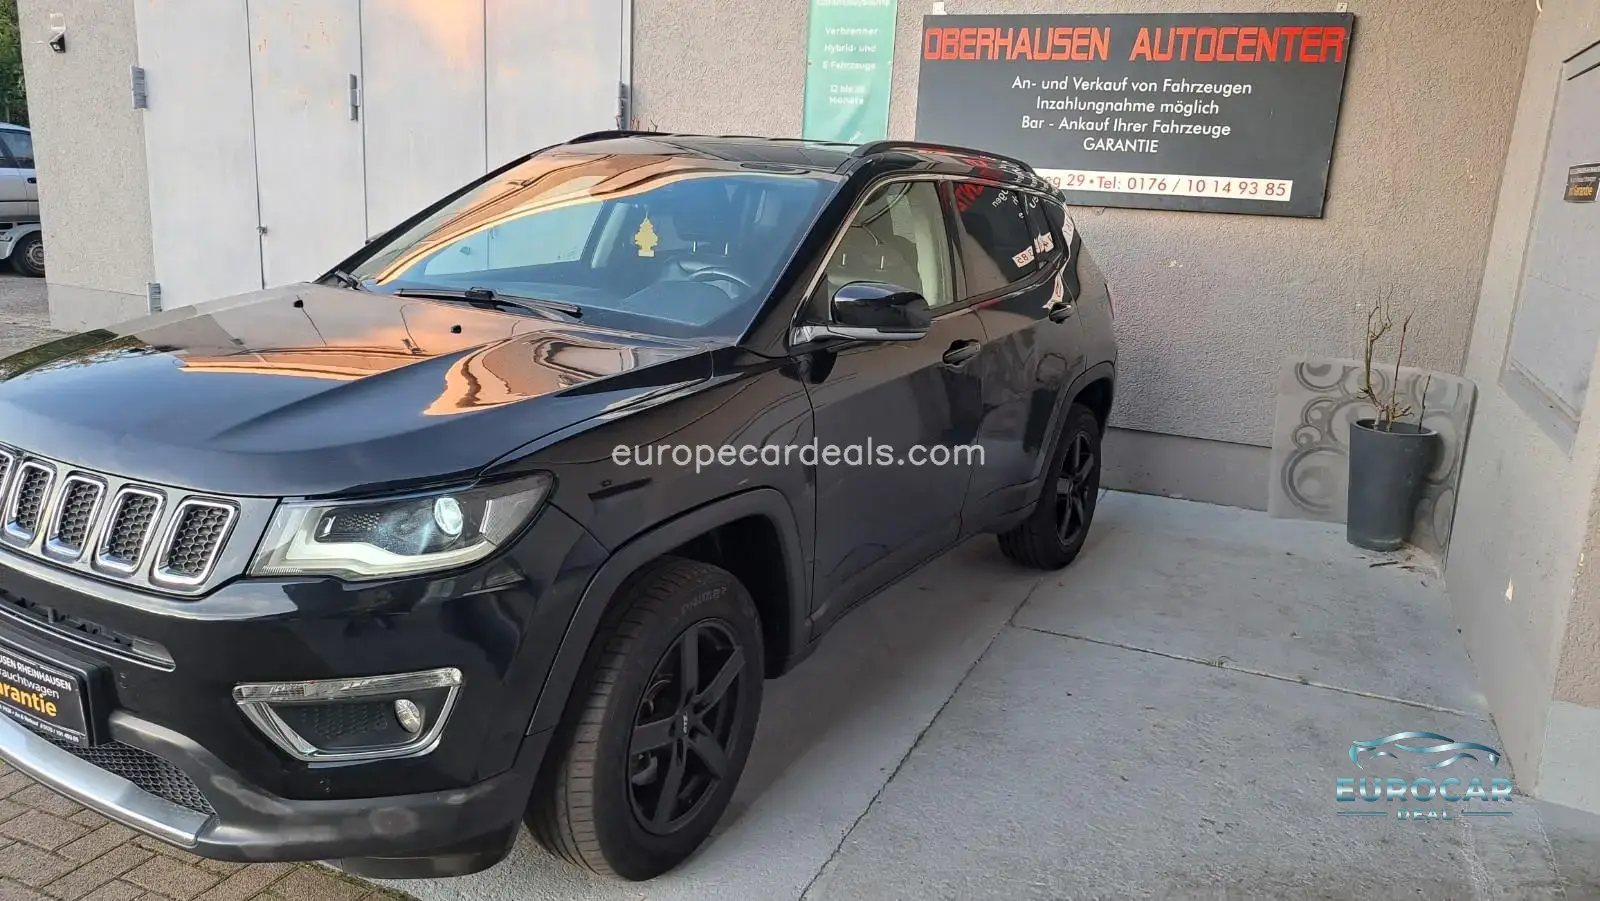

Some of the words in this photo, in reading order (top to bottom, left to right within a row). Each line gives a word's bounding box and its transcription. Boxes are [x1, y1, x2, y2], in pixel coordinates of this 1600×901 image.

[824, 26, 879, 36] Verbrenner
[924, 26, 1111, 61] OBERHAUSEN
[1129, 26, 1346, 63] AUTOCENTER
[1012, 75, 1037, 89] An-
[1041, 76, 1069, 90] und
[1072, 76, 1129, 91] Verkauf
[1131, 81, 1158, 92] von
[1162, 77, 1252, 97] Fahrzeugen
[1036, 95, 1156, 115] Inzahlungnahme
[1160, 99, 1219, 117] möglich
[1021, 115, 1045, 129] Bar
[1058, 116, 1111, 131] Ankauf
[1113, 117, 1148, 133] Ihrer
[1152, 119, 1232, 139] Fahrzeuge
[1083, 137, 1160, 153] GARANTIE
[1066, 173, 1085, 187] 29
[1097, 175, 1121, 189] Tel:
[1127, 176, 1167, 191] 0176
[1187, 179, 1206, 193] 10
[1213, 180, 1232, 194] 14
[1238, 181, 1259, 195] 93
[1264, 182, 1286, 197] 85
[17, 663, 72, 692] RHEINHAUSEN
